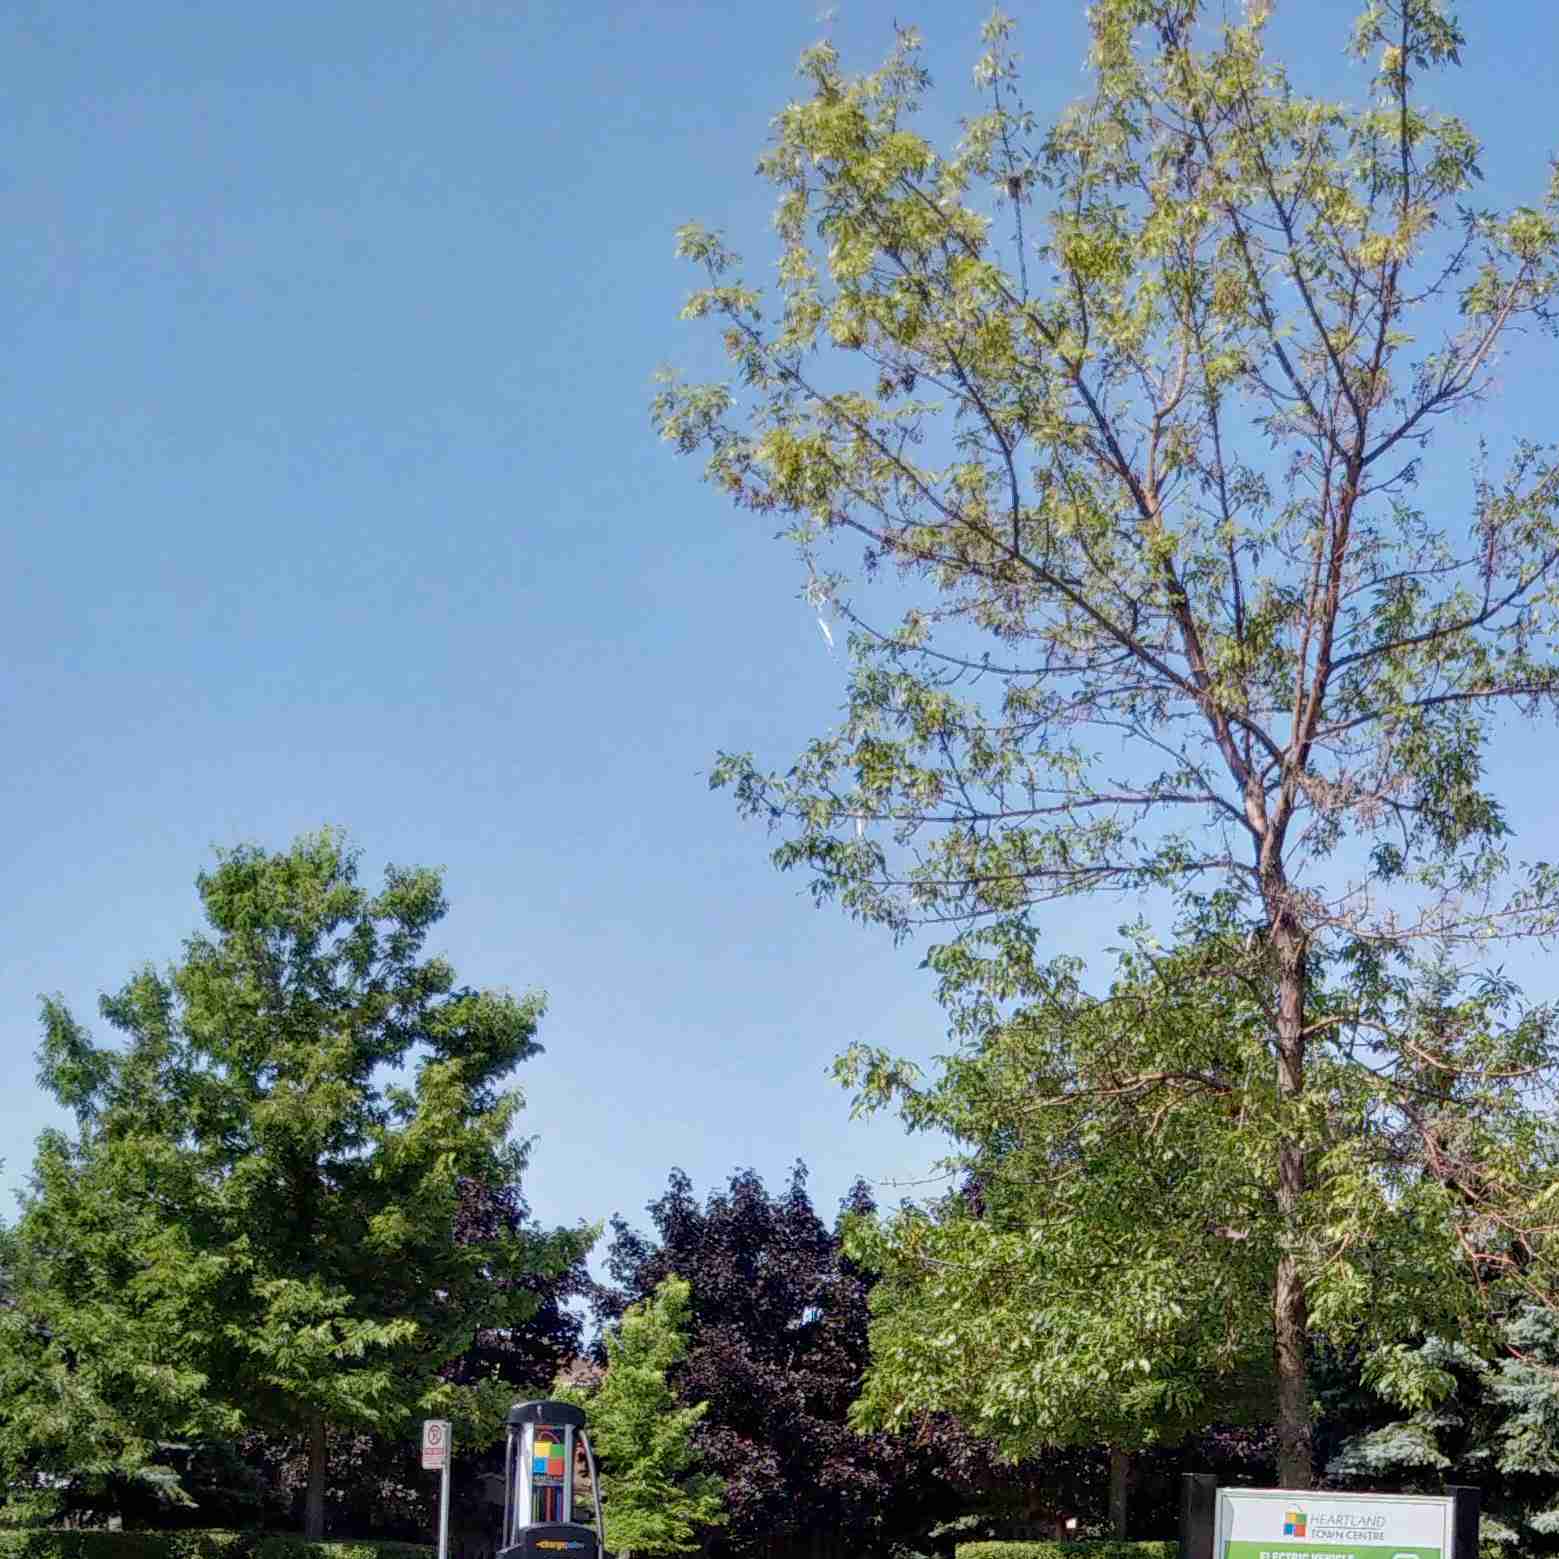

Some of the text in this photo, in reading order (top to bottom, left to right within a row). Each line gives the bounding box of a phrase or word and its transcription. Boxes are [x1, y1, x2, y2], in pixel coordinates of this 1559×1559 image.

[1311, 1512, 1385, 1528] HEARTLAND
[1311, 1528, 1385, 1541] TOWN CENTRE
